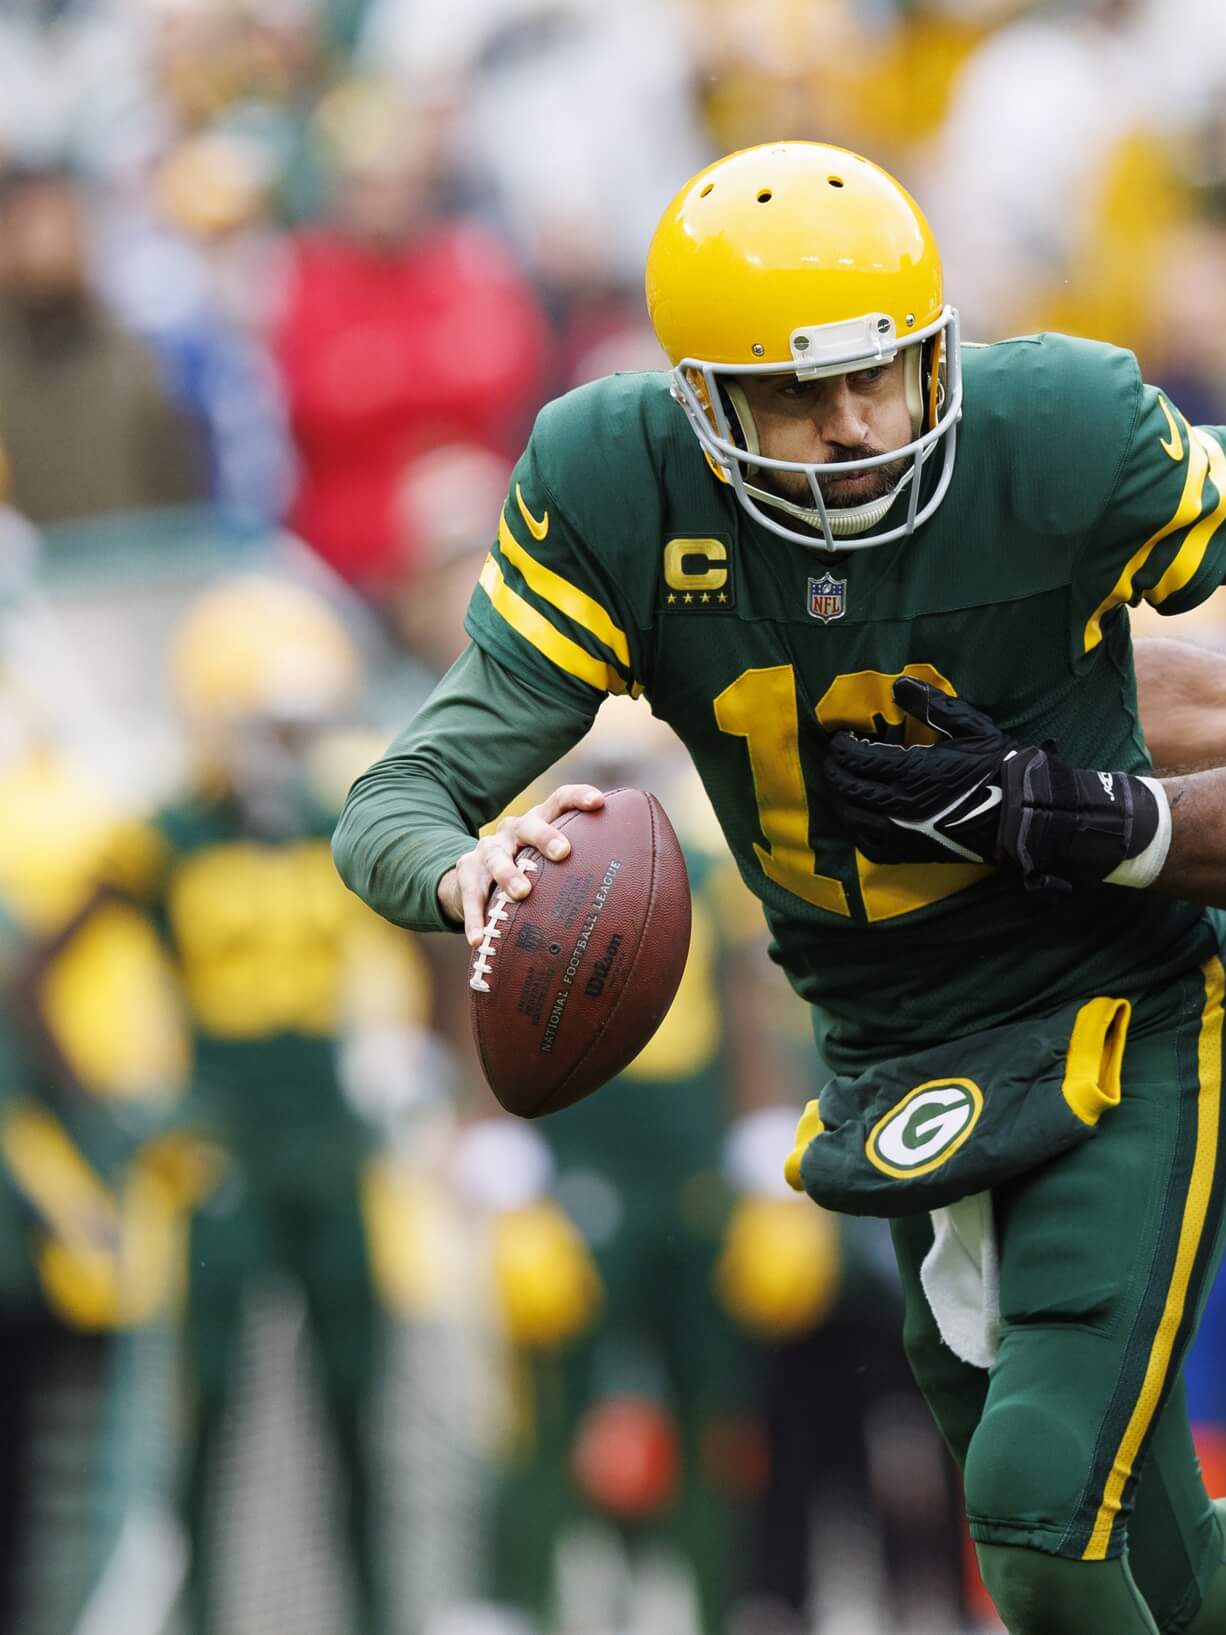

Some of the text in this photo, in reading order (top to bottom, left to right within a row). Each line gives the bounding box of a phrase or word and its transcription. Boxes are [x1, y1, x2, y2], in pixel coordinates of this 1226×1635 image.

[664, 538, 728, 590] C
[813, 596, 840, 614] NFL
[541, 990, 569, 1054] NATIONAL
[563, 914, 598, 985] FOOTBALL
[592, 859, 622, 910] LEAGUE
[584, 932, 624, 998] Wilson
[876, 1086, 974, 1168] G
